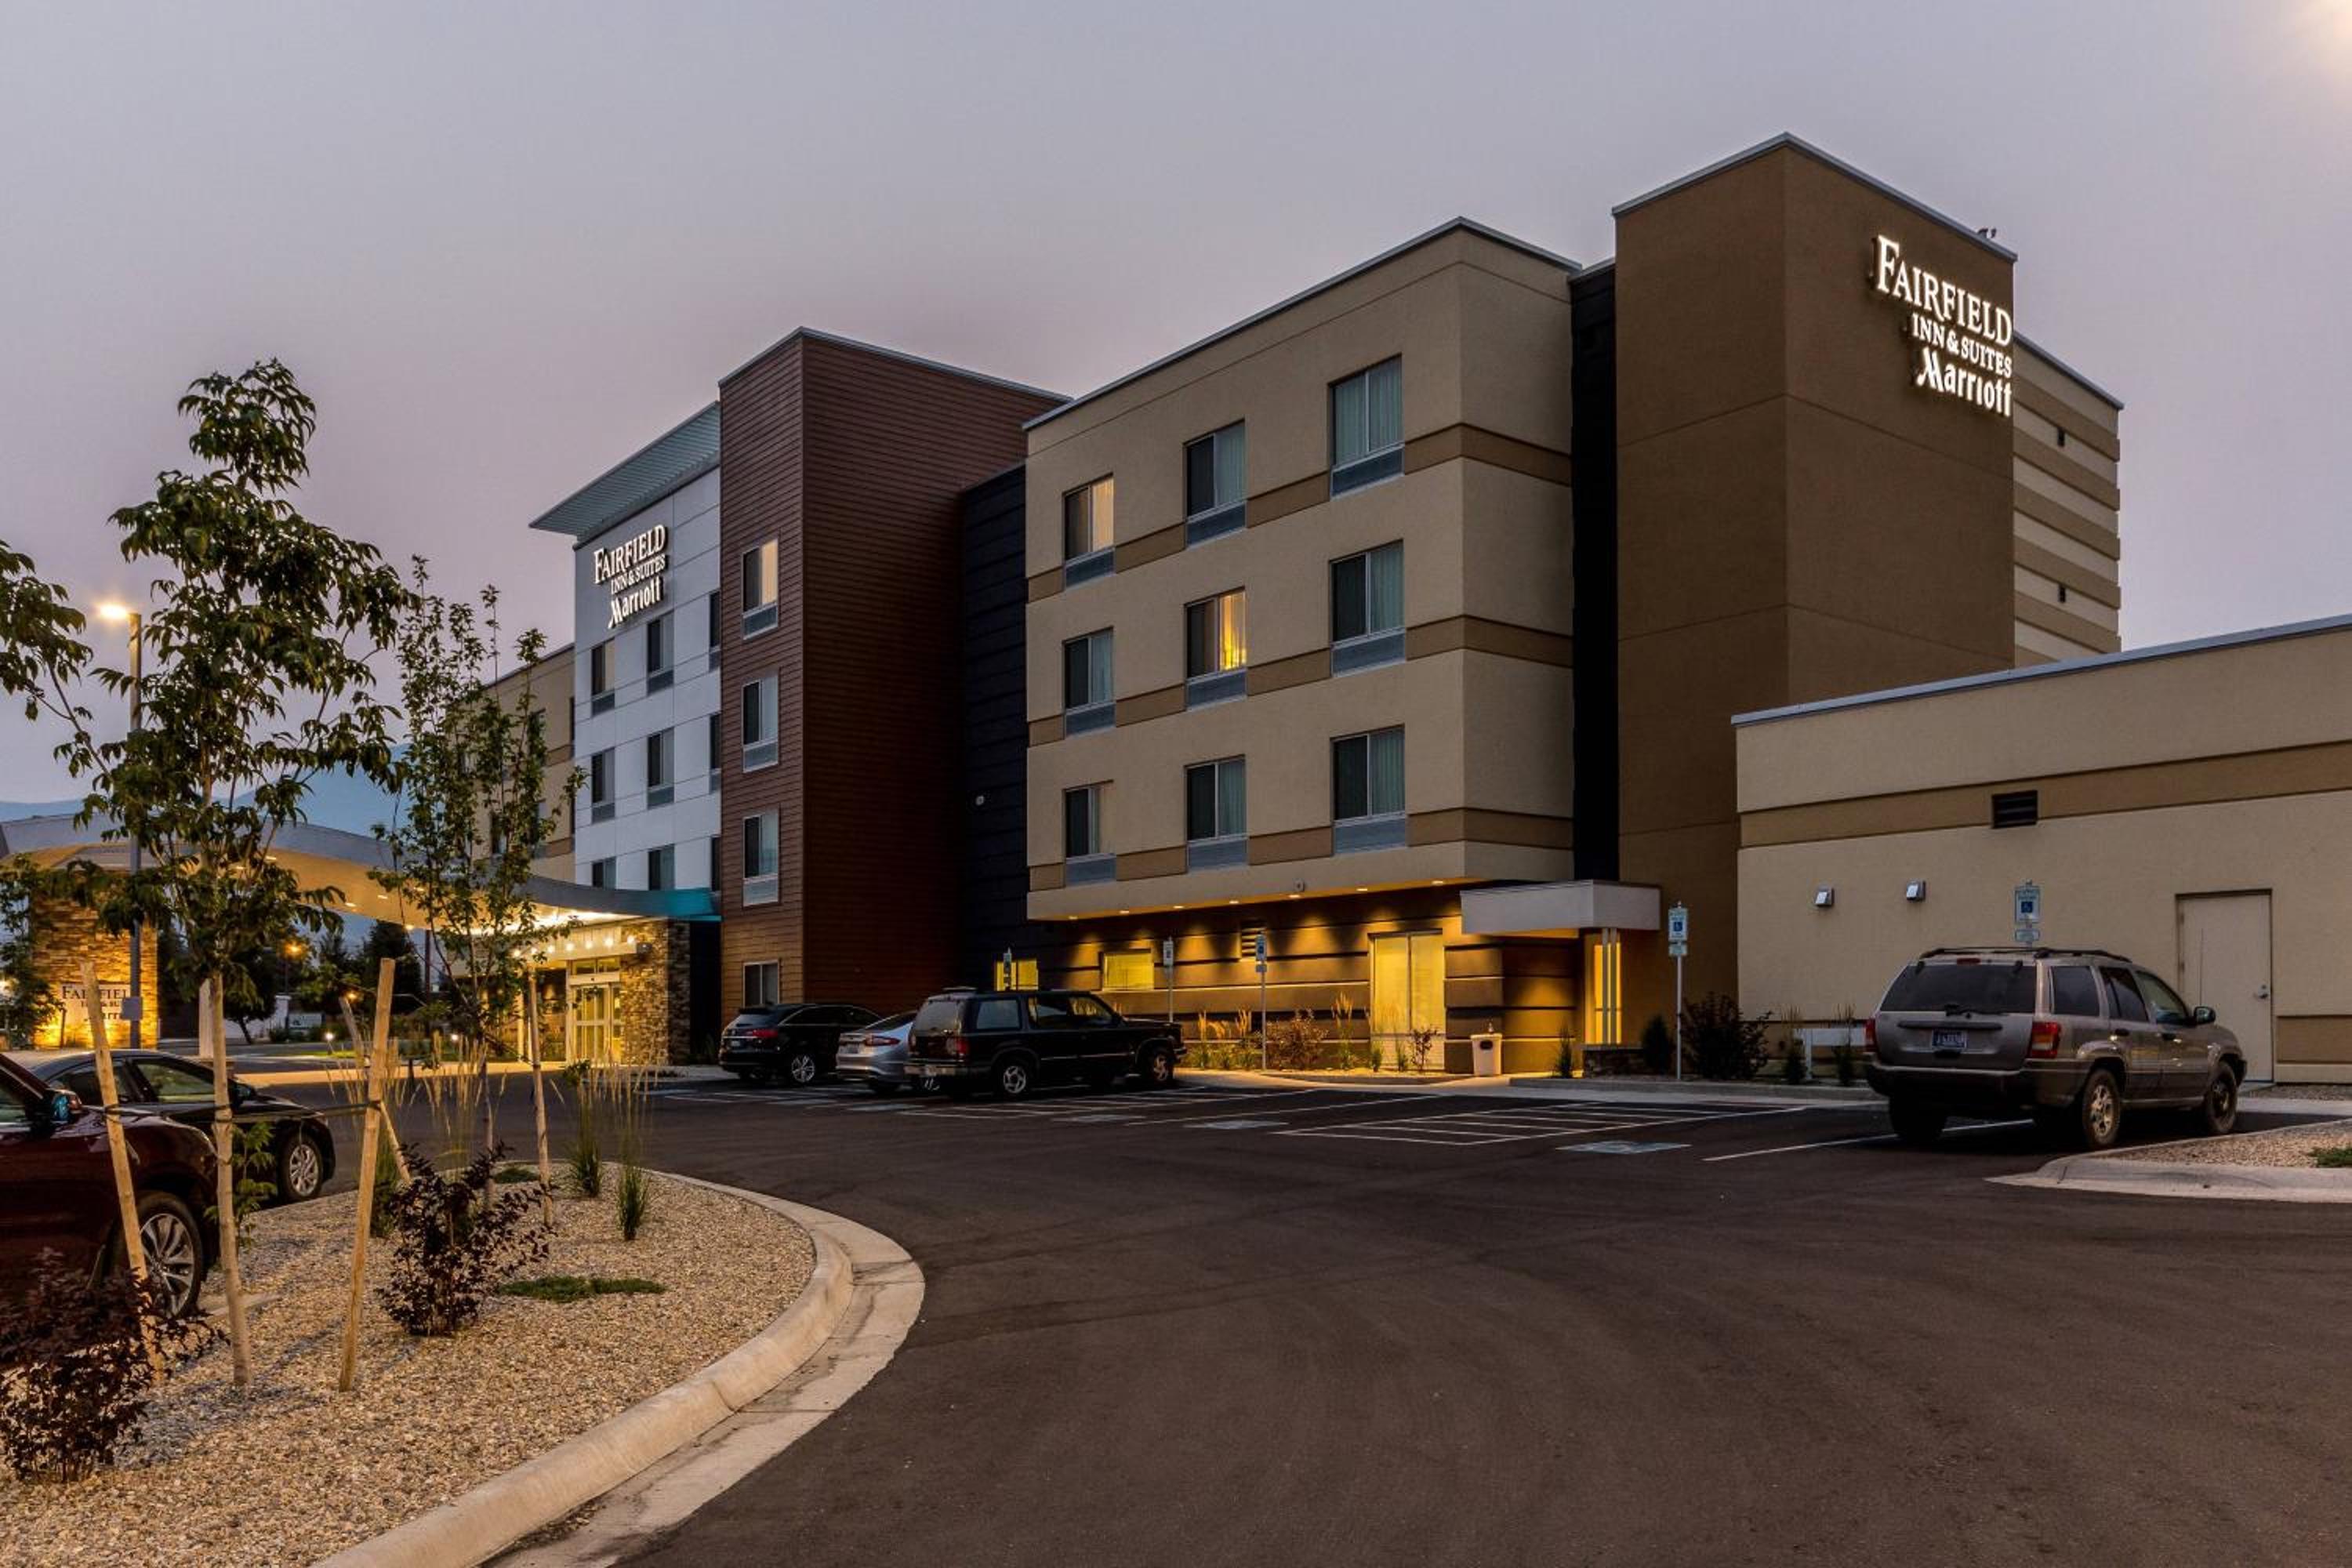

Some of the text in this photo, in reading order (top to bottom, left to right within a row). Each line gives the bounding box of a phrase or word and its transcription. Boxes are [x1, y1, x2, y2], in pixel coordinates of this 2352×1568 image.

[1877, 234, 2012, 347] FAIRFIELD
[1916, 347, 2012, 416] Marriott
[593, 524, 666, 584] FAIRFIELD
[608, 575, 661, 630] Marriott
